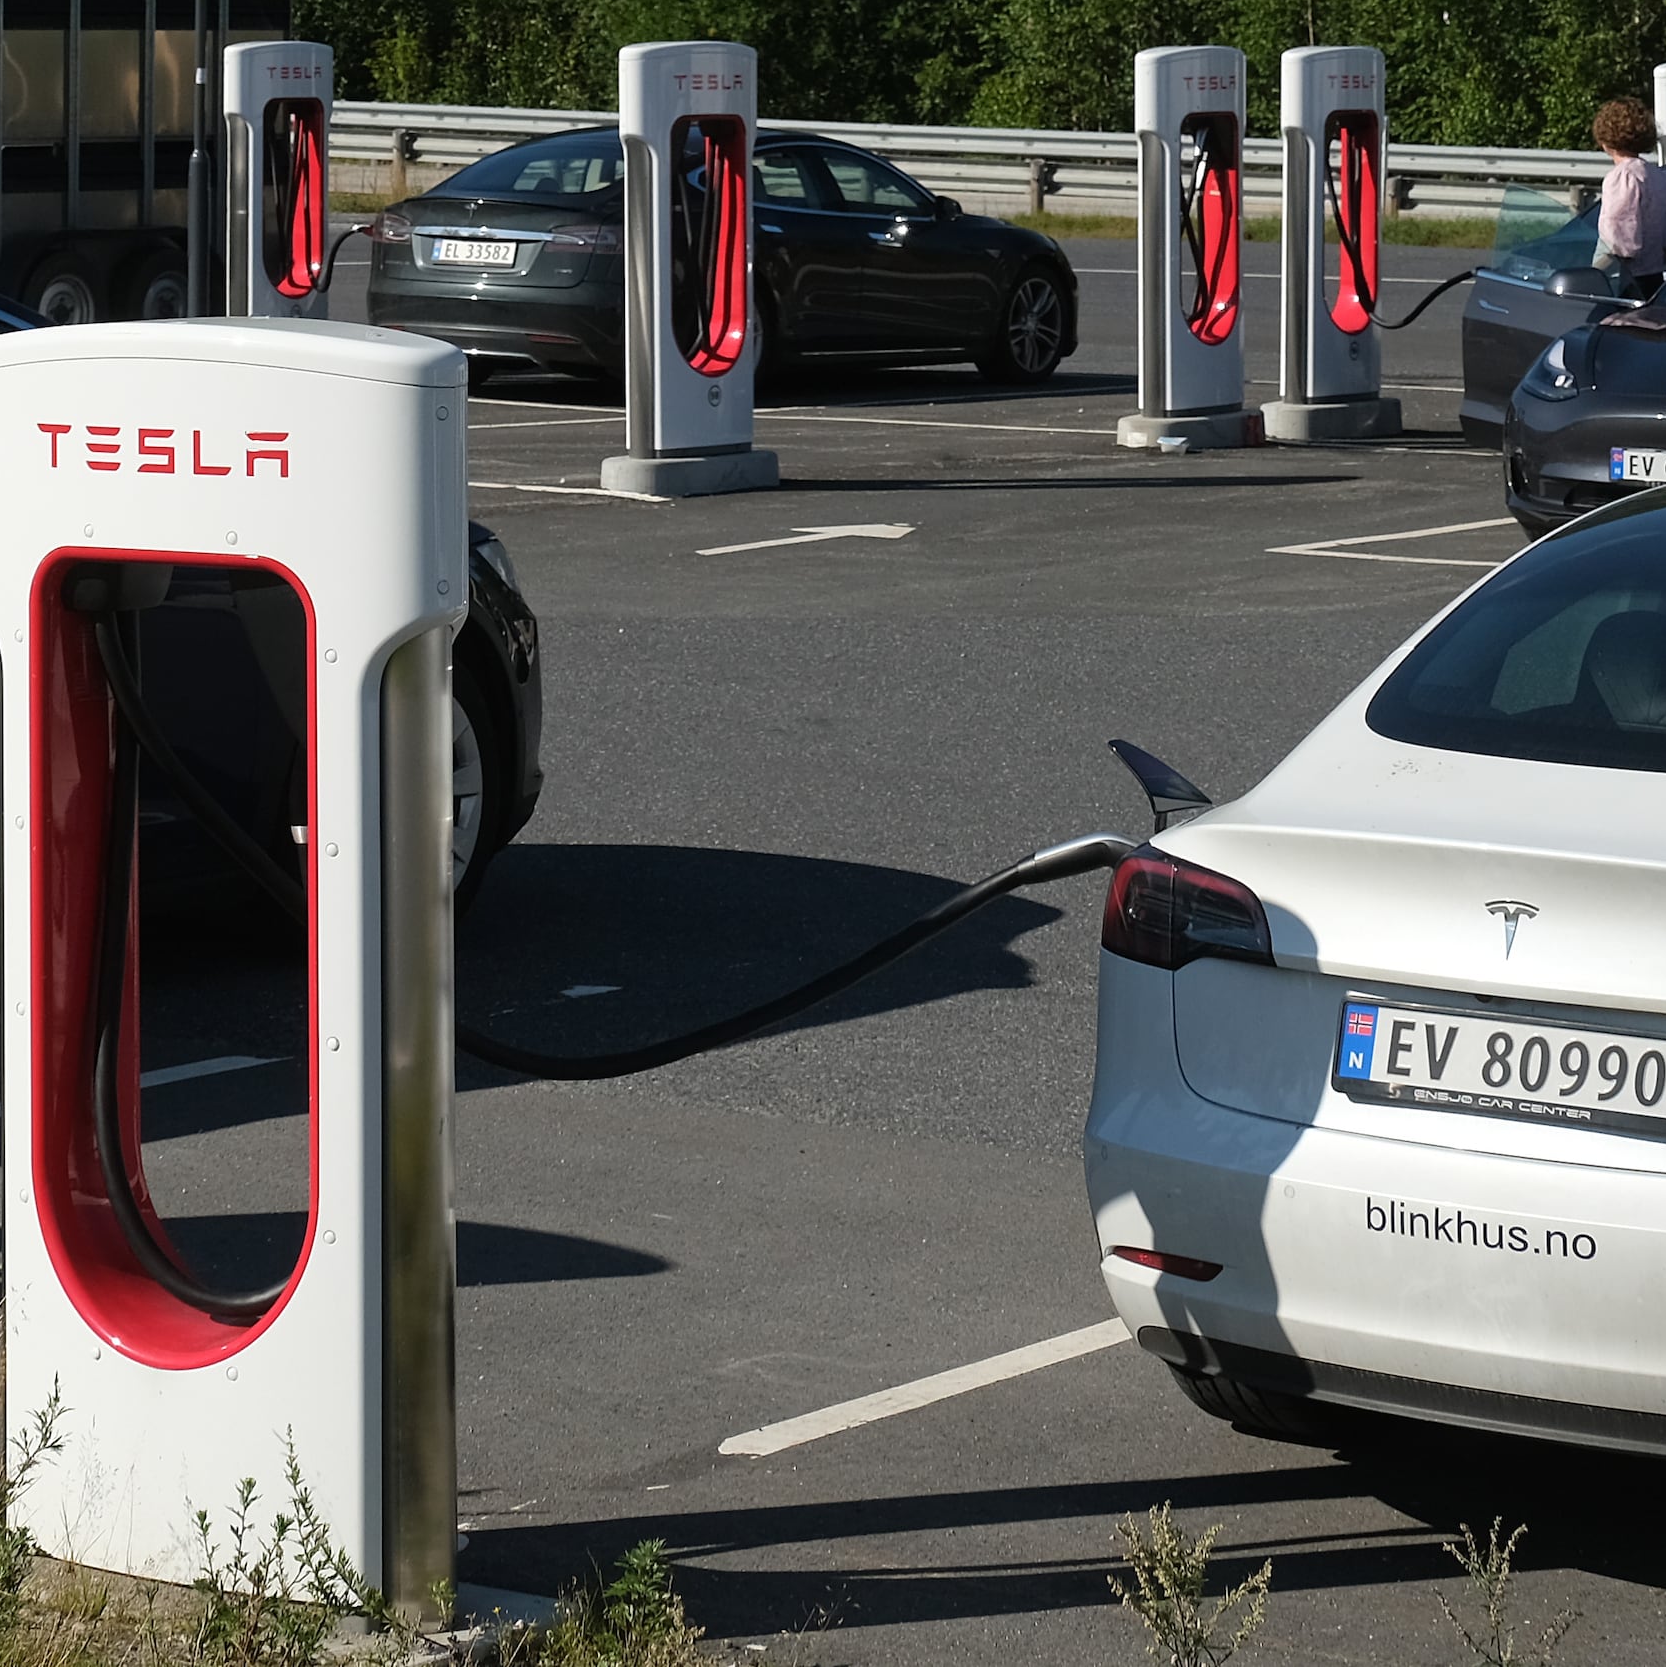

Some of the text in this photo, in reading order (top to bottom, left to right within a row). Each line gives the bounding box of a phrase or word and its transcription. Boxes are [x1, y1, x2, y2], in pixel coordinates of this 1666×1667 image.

[266, 66, 322, 79] TESLA
[673, 74, 742, 91] TESLA
[1184, 75, 1236, 90] TESLA
[444, 243, 510, 261] EL 33582
[37, 423, 289, 478] TESLA
[1629, 455, 1654, 476] EV
[1386, 1019, 1666, 1106] EV 80990
[1478, 1097, 1514, 1110] CAR
[1519, 1103, 1593, 1121] CENTER
[1366, 1196, 1597, 1260] blinkhus.no
